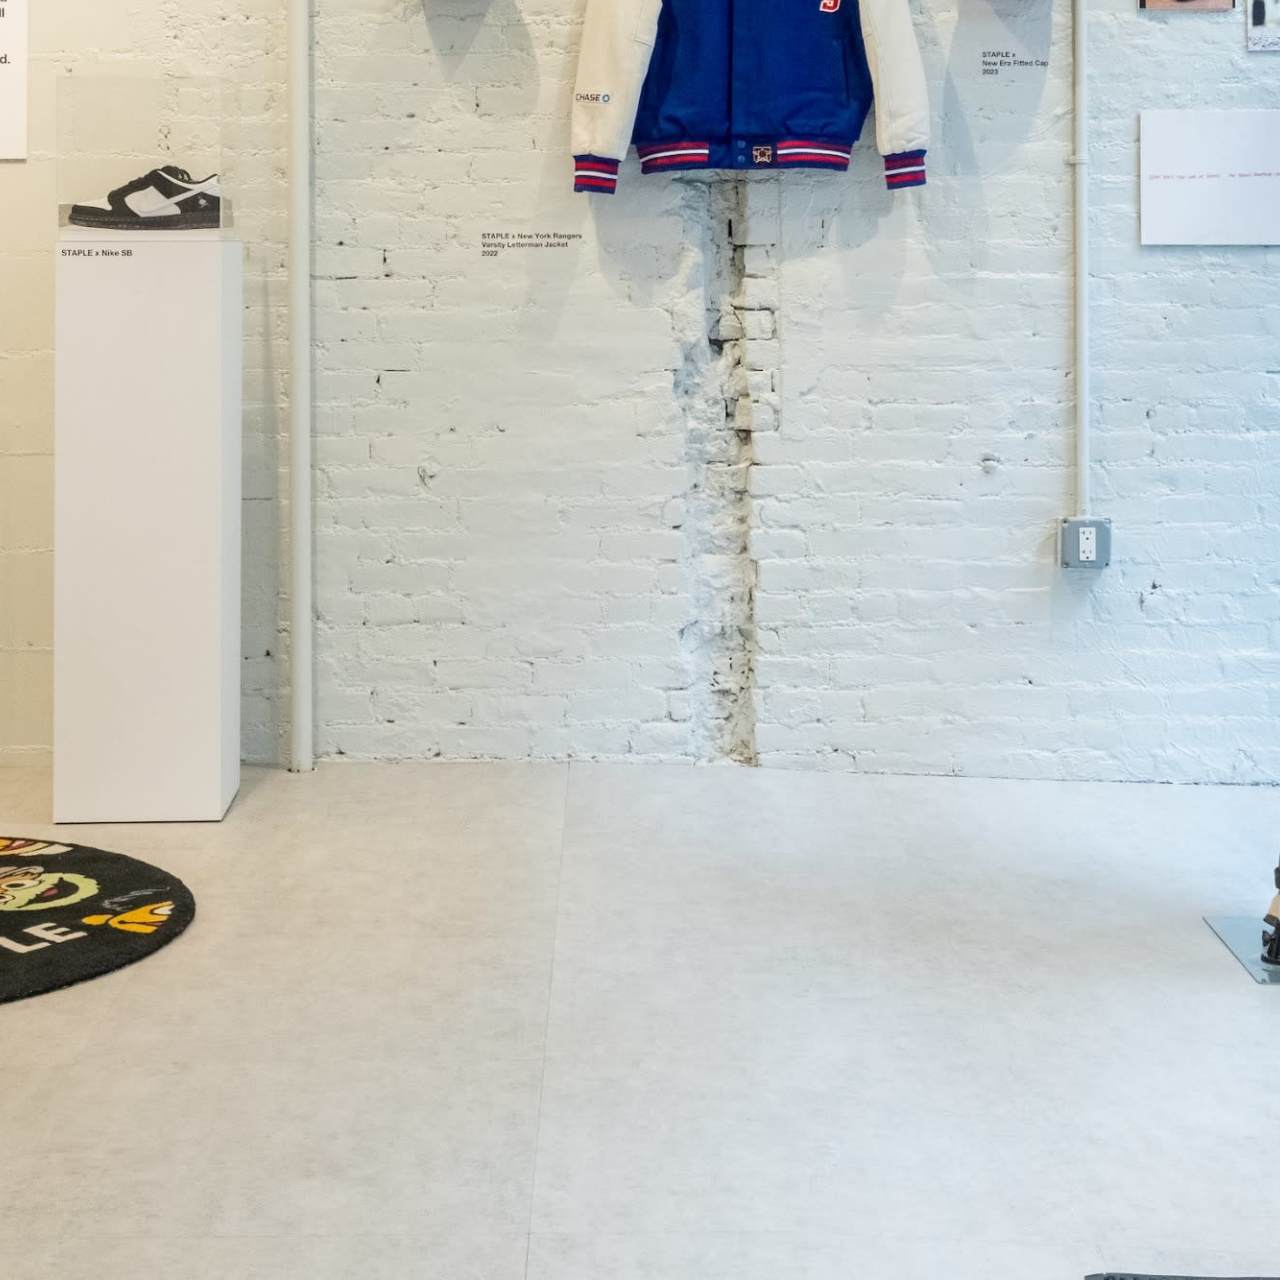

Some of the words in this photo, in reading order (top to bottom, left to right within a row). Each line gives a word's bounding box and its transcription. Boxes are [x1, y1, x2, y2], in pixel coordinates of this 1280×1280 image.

[1035, 60, 1049, 68] Cap
[575, 93, 601, 102] CHASE
[553, 233, 582, 241] Rangers
[481, 241, 506, 249] Varsity
[61, 249, 93, 257] STAPLE
[101, 249, 120, 257] Nike
[121, 249, 133, 257] SB
